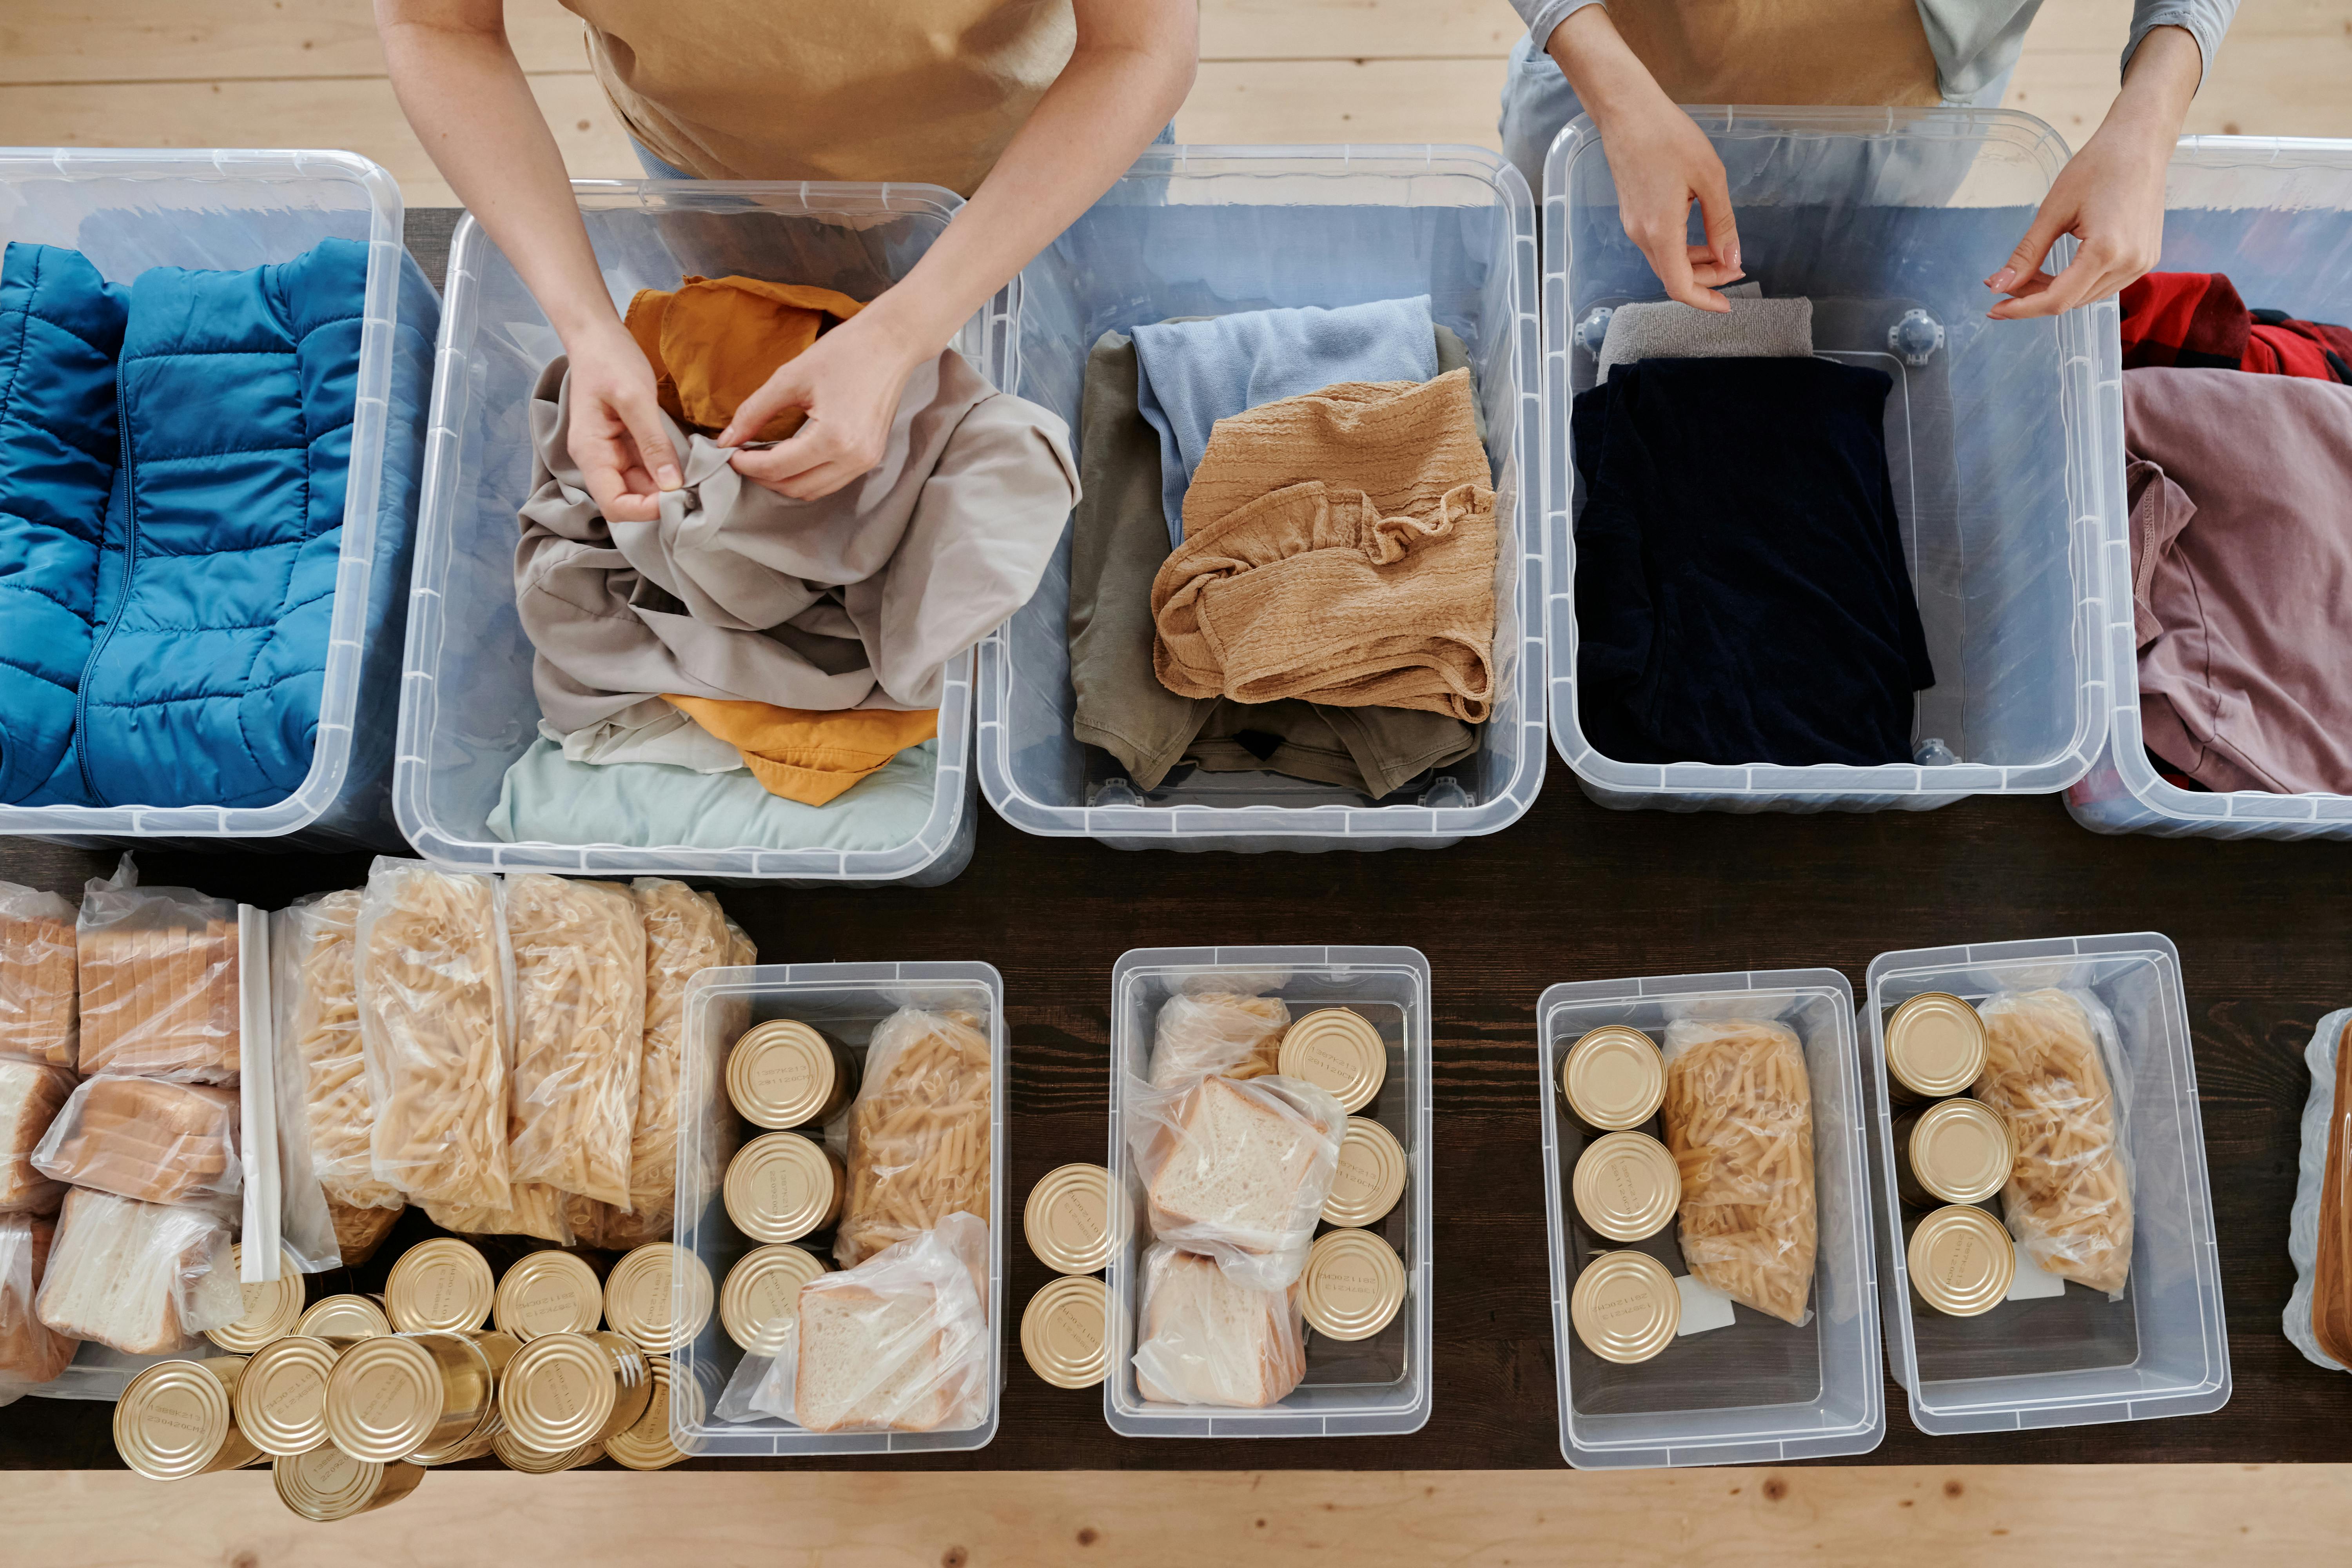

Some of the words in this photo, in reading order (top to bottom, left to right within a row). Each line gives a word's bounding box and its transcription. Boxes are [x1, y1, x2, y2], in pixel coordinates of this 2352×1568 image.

[756, 1065, 807, 1077] 1387K213
[1307, 1056, 1360, 1085] 281120CM2
[1310, 1046, 1357, 1072] 1387K213
[780, 1169, 788, 1215] 1387K213
[1619, 1160, 1641, 1210] 1387K213
[1943, 1233, 1964, 1292] 281120CM2
[1955, 1236, 1974, 1287] 1387K213
[1318, 1273, 1376, 1284] 281120CM2
[1325, 1284, 1376, 1294] 1387K213
[430, 1269, 446, 1321] 1388K213
[515, 1292, 575, 1309] 281120CM2
[655, 1274, 672, 1325] 1387K213
[1591, 1292, 1648, 1312] 281120CM2
[525, 1301, 577, 1318] 1387K213
[1602, 1302, 1651, 1320] 1387K213
[1056, 1316, 1094, 1356] 1388K213
[147, 1415, 206, 1434] 230420CM2
[149, 1405, 201, 1421] 1388K213
[313, 1447, 341, 1474] 1388K2
[320, 1454, 350, 1482] 220920
